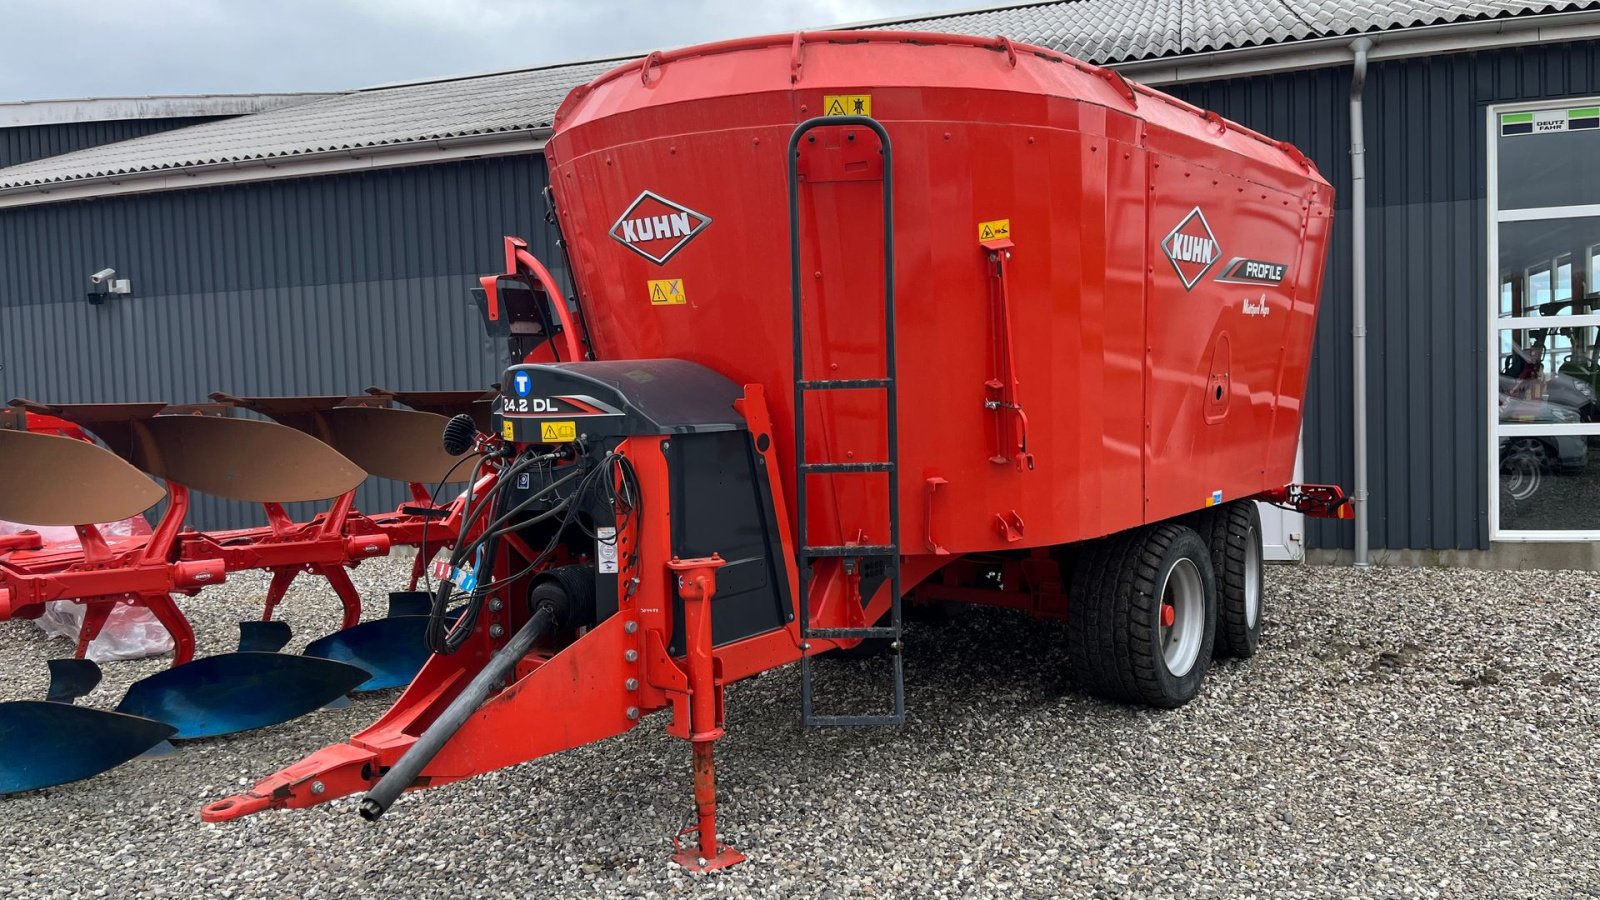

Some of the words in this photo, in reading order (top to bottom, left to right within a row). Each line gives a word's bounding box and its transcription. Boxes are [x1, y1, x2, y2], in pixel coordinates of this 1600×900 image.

[622, 212, 691, 243] KUHN
[1172, 232, 1213, 264] KUHN
[1246, 262, 1283, 281] PROFILE
[516, 376, 528, 392] T
[504, 398, 528, 412] 24.2
[534, 398, 558, 412] DL
